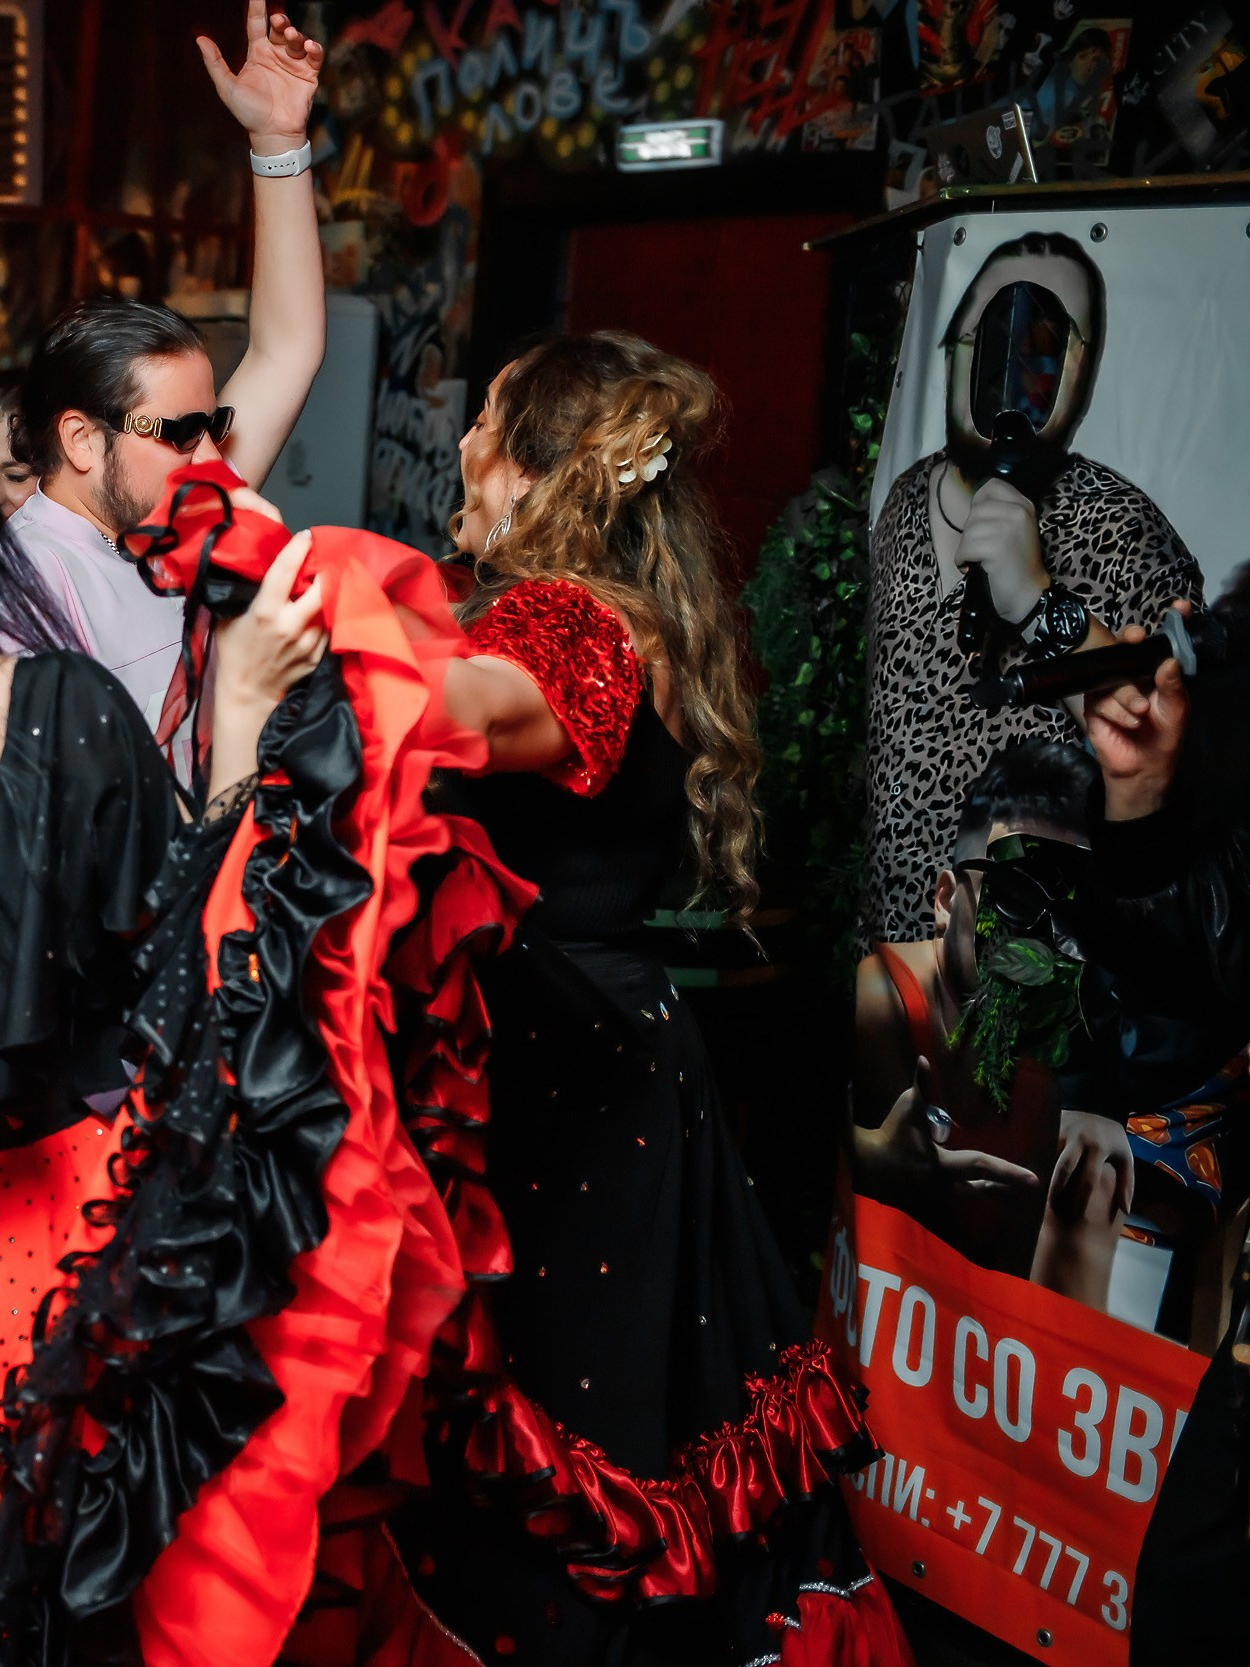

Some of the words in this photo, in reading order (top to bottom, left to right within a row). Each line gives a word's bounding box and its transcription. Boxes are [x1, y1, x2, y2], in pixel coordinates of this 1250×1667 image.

[953, 1315, 1036, 1443] СО
[946, 1495, 1002, 1556] +7
[1012, 1515, 1091, 1606] 777
